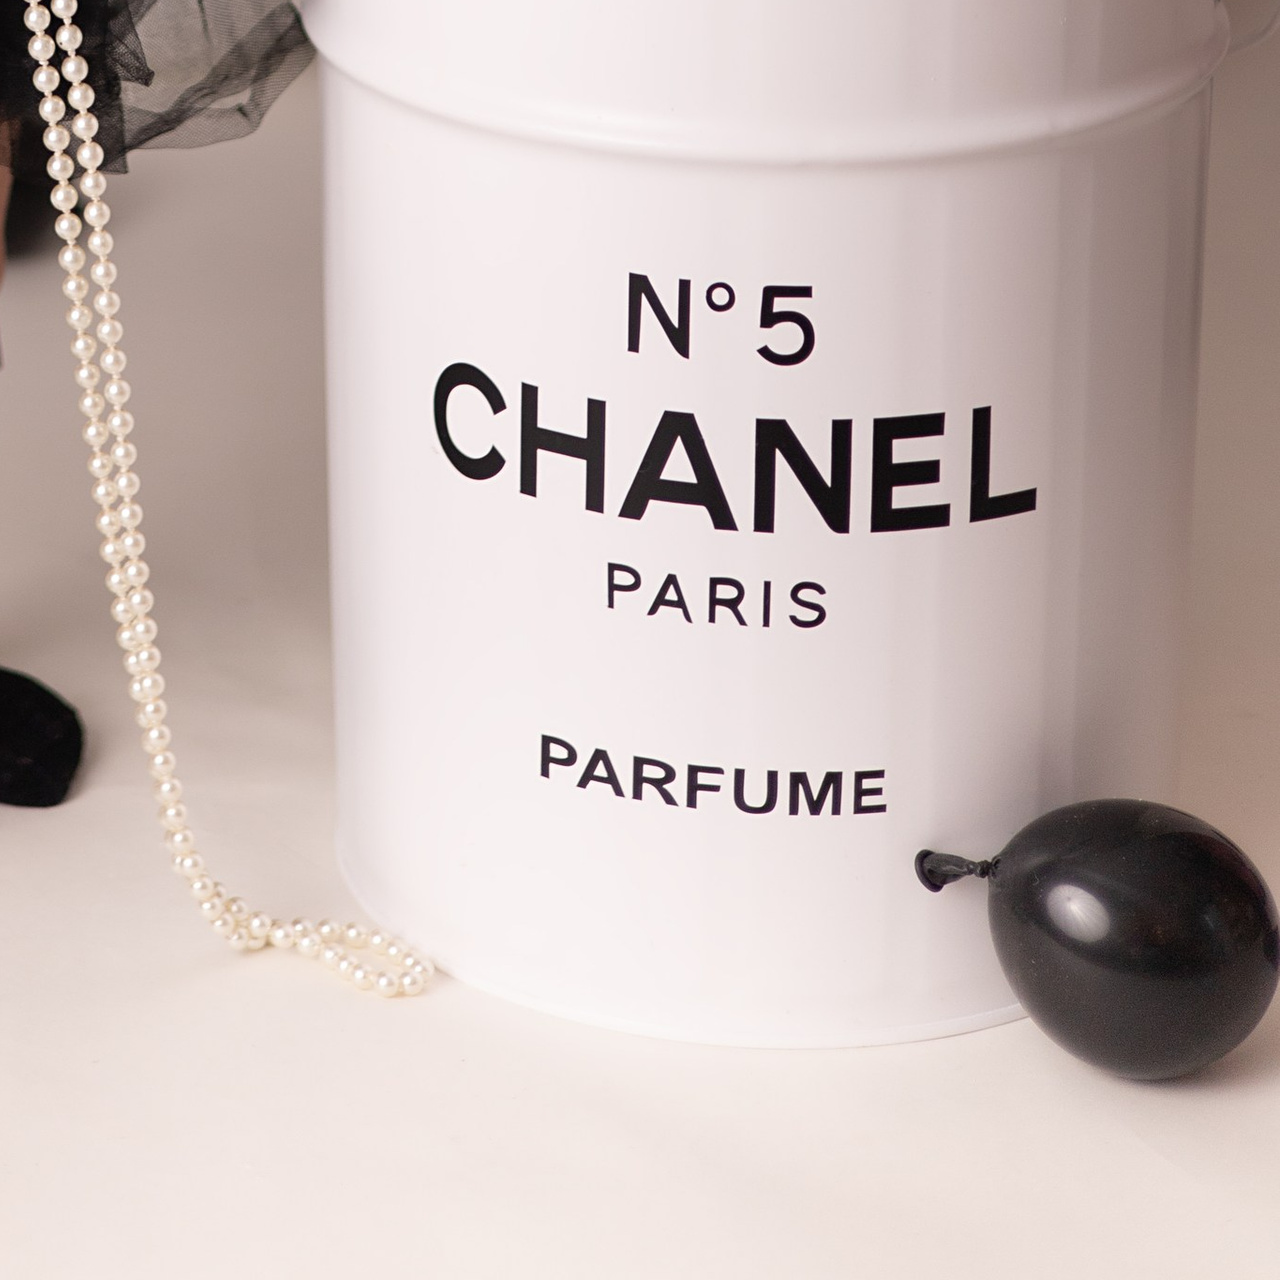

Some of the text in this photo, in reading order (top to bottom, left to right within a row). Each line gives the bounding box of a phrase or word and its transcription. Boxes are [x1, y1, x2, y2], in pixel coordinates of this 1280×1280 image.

[433, 362, 1038, 534] CHANEL
[607, 562, 827, 629] PARIS
[540, 734, 887, 816] PARFUME
